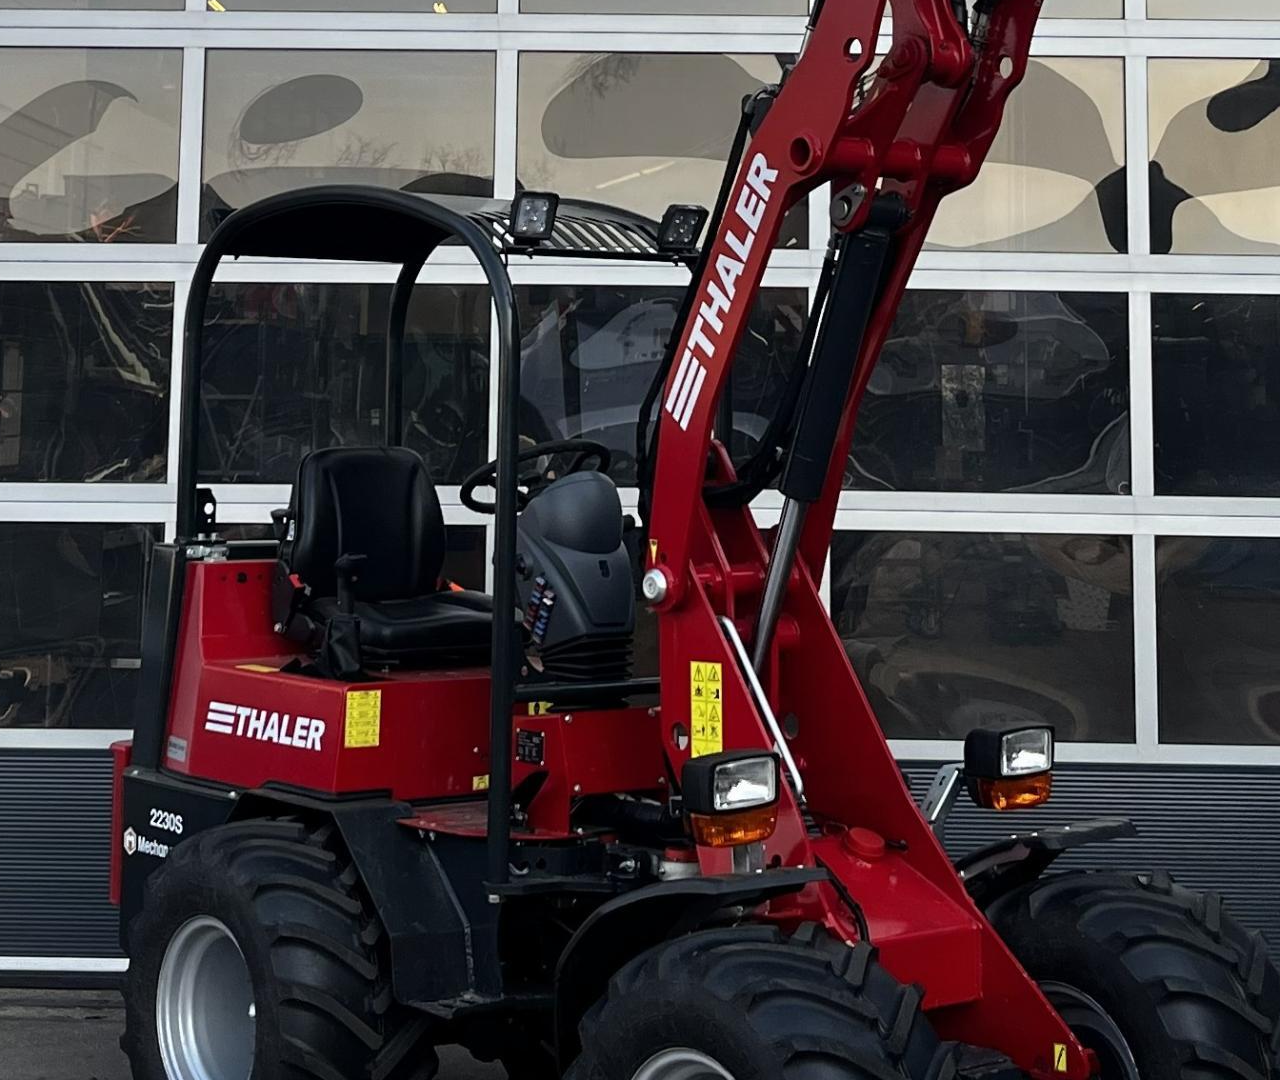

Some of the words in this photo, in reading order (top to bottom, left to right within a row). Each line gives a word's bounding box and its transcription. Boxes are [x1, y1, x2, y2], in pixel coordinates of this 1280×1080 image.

[687, 152, 778, 358] THALER
[236, 705, 325, 751] THALER
[149, 808, 183, 835] 2230S
